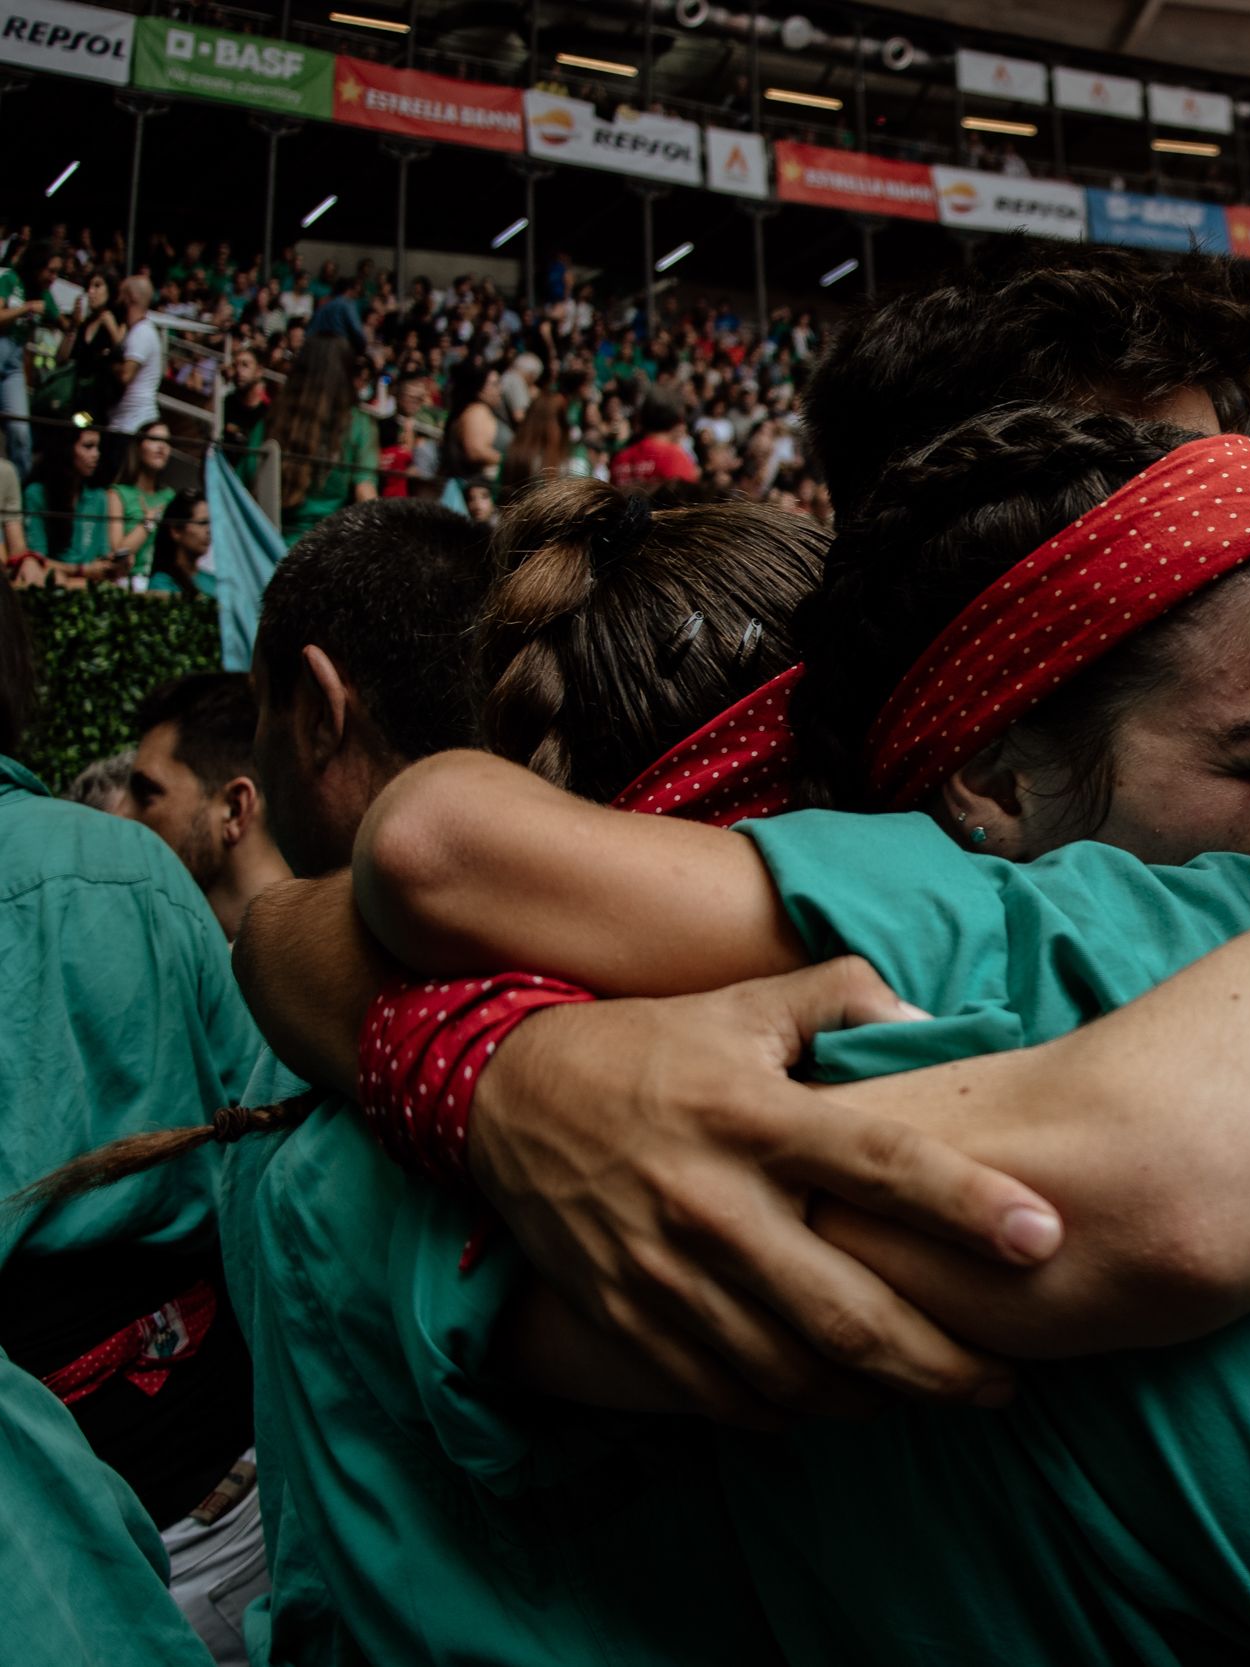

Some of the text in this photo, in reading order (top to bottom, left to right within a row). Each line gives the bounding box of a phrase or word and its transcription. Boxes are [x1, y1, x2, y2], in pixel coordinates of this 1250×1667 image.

[2, 15, 126, 59] REPSOL
[213, 37, 305, 80] BASF
[364, 87, 457, 122] ESTRELLA
[594, 128, 693, 160] REPSOL
[993, 196, 1079, 221] REPSOL
